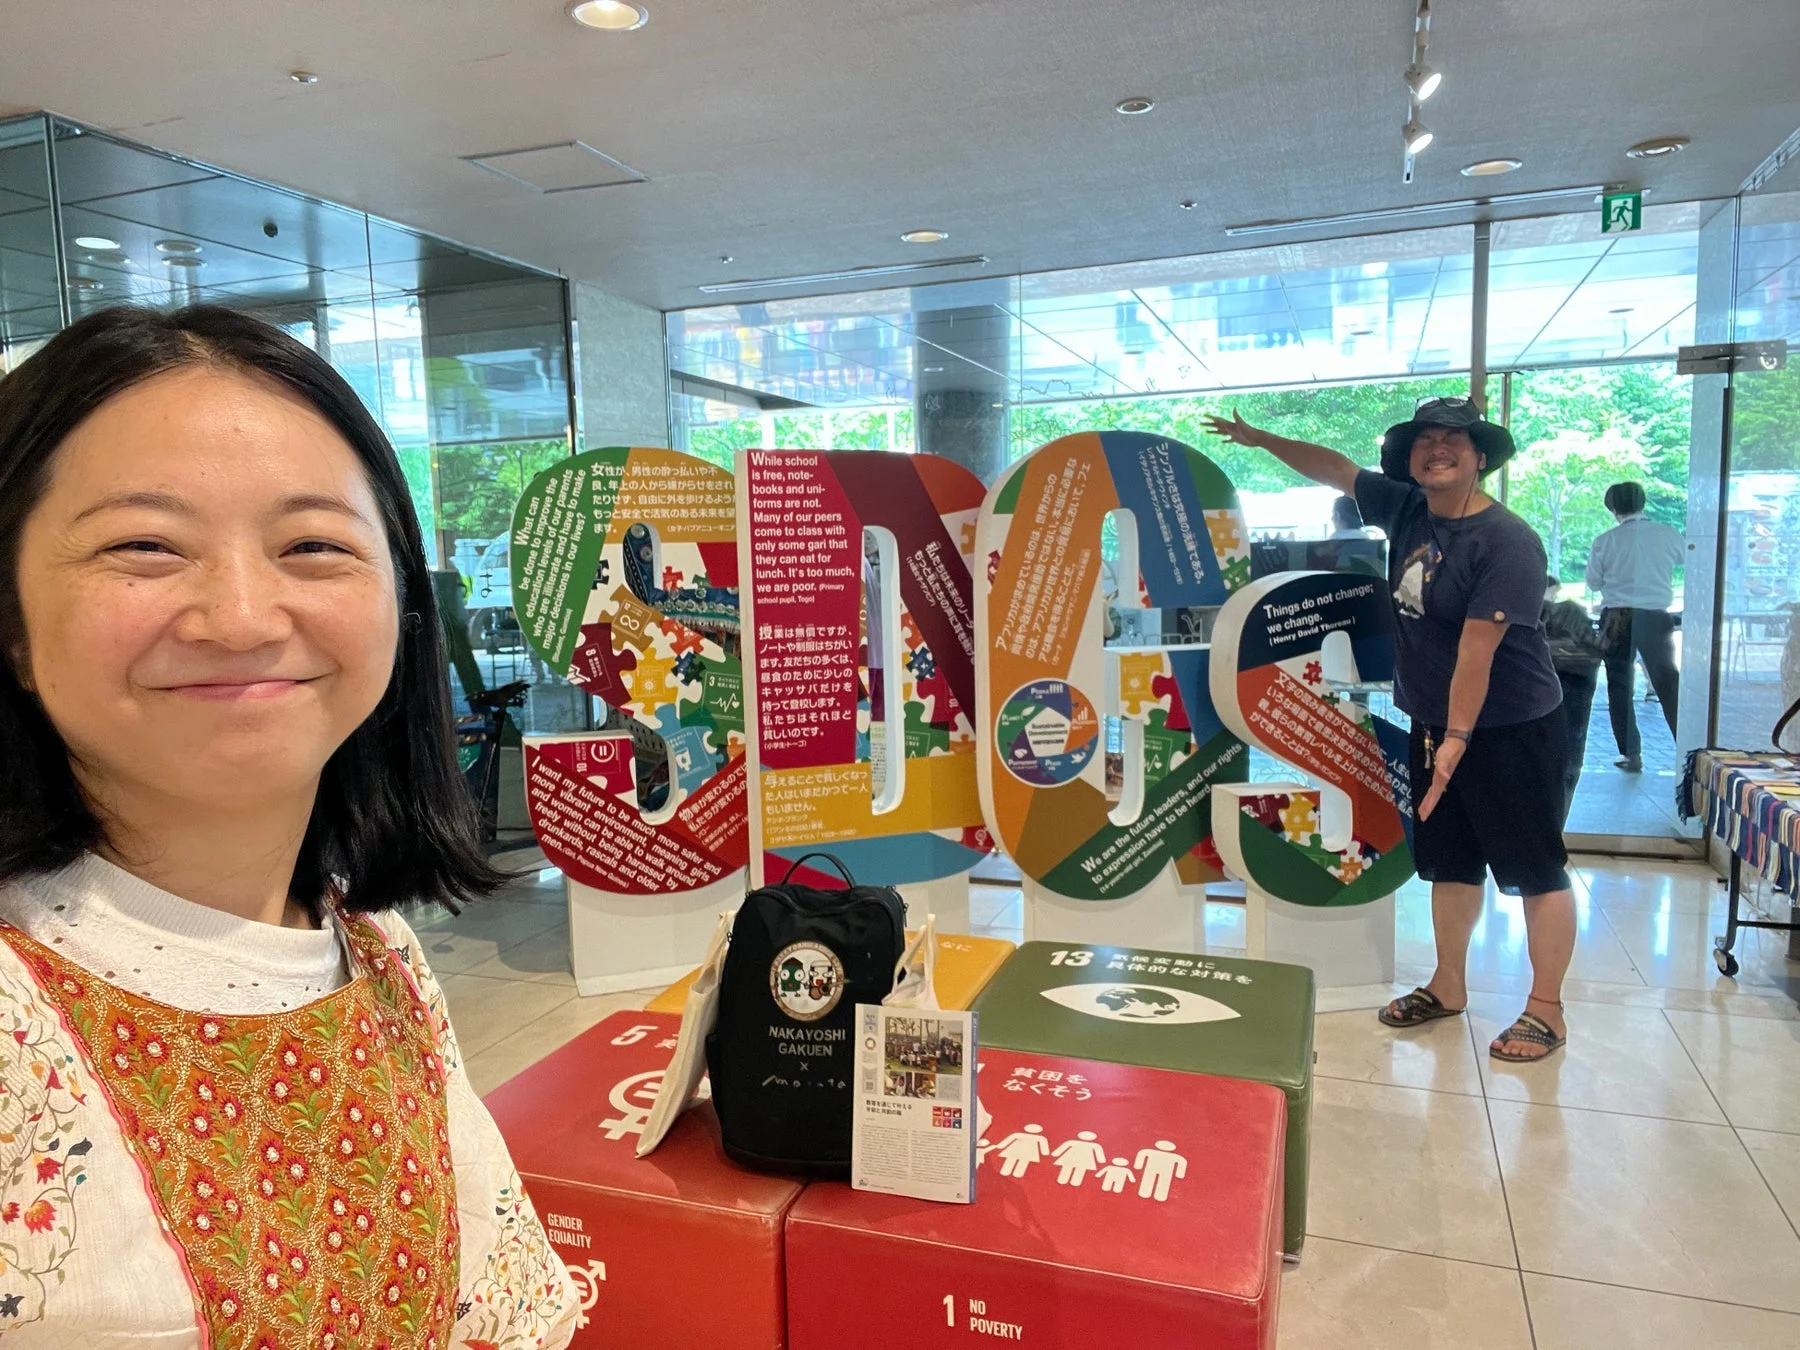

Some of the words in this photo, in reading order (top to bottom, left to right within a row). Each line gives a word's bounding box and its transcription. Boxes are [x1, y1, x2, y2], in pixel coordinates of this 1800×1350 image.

[751, 452, 782, 466] While
[785, 456, 818, 466] school
[752, 470, 761, 481] is
[763, 470, 786, 482] free,
[788, 470, 814, 480] note-
[752, 484, 783, 494] books
[786, 484, 804, 494] and
[807, 484, 826, 494] uni-
[753, 498, 782, 509] forms
[785, 500, 800, 508] are
[803, 498, 822, 508] not.
[754, 512, 781, 524] Many
[783, 511, 794, 522] of
[796, 513, 813, 522] our
[815, 512, 842, 524] peers
[514, 516, 534, 545] What
[523, 550, 538, 575] done
[533, 496, 553, 536] improve
[594, 523, 617, 534] ます。
[754, 528, 782, 537] come
[785, 526, 795, 536] to
[797, 525, 823, 536] class
[825, 525, 846, 535] with
[526, 569, 546, 618] education
[537, 539, 554, 568] levels
[557, 469, 573, 508] parents
[755, 540, 776, 553] only
[778, 541, 805, 550] some
[808, 539, 827, 554] gari
[829, 539, 848, 550] that
[533, 615, 545, 637] who
[542, 556, 562, 596] illiterate
[572, 469, 586, 497] make
[756, 554, 777, 567] they
[780, 556, 797, 565] can
[800, 554, 816, 564] eat
[818, 552, 832, 563] for
[543, 620, 556, 649] major
[550, 572, 570, 619] decisions
[562, 556, 573, 571] in
[570, 512, 586, 542] lives?
[756, 568, 786, 579] lunch.
[789, 567, 805, 578] It's
[807, 567, 824, 578] too
[825, 566, 855, 578] much,
[757, 583, 772, 593] we
[774, 583, 790, 593] are
[792, 582, 817, 593] poor.
[1263, 603, 1300, 619] Things
[1302, 598, 1315, 610] do
[1316, 592, 1334, 606] not
[1335, 583, 1374, 601] change;
[1267, 623, 1282, 634] we
[1284, 613, 1323, 630] change.
[1297, 625, 1319, 638] David
[585, 648, 596, 656] 8
[709, 676, 715, 687] 3
[761, 668, 852, 683] 昼食のために少しの
[761, 682, 852, 697] キャッサバだけを
[763, 710, 851, 725] 私たちはそれほど
[763, 727, 824, 740] 貧しいのです。
[576, 762, 587, 772] 10
[532, 756, 540, 768] I
[539, 763, 562, 781] want
[562, 778, 578, 792] my
[579, 786, 605, 807] future
[632, 819, 656, 837] much
[681, 848, 703, 864] safer
[1081, 856, 1102, 873] We
[1102, 844, 1116, 860] are
[1115, 834, 1130, 848] the
[1129, 813, 1155, 837] future
[1153, 788, 1189, 817] leaders,
[1187, 772, 1204, 791] and
[1203, 763, 1218, 777] our
[1217, 743, 1243, 766] rights
[531, 773, 556, 791] more
[560, 790, 591, 813] vibrant
[594, 810, 647, 848] environment,
[652, 844, 688, 870] meaning
[690, 867, 710, 882] girls
[535, 801, 561, 823] freely
[564, 819, 597, 842] without
[598, 838, 623, 860] being
[625, 854, 666, 882] harassed
[666, 877, 679, 890] by
[551, 798, 583, 820] women
[602, 826, 614, 838] be
[614, 836, 634, 850] able
[634, 846, 644, 856] to
[645, 853, 665, 869] walk
[665, 866, 697, 886] around
[1092, 873, 1103, 884] to
[1103, 837, 1147, 876] expression
[1144, 822, 1167, 841] have
[1165, 814, 1177, 825] to
[1175, 804, 1188, 817] be
[538, 819, 584, 851] drunkards,
[586, 846, 618, 868] rascals
[619, 864, 637, 879] and
[637, 875, 660, 891] older
[1050, 951, 1095, 966] 13
[1111, 953, 1216, 969] 気候変動に
[1106, 961, 1253, 984] 具体的な対策を
[610, 1025, 659, 1045] 5
[769, 1026, 846, 1041] NAKAYOSHI
[778, 1042, 833, 1056] GAKUEN
[1011, 1067, 1088, 1085] 貧困を
[1003, 1079, 1092, 1100] なくそう
[547, 1213, 583, 1231] GENDER
[549, 1229, 591, 1248] EQUALITY
[943, 1294, 955, 1327] 1
[969, 1299, 986, 1315] NO
[970, 1317, 1023, 1340] POVERTY
